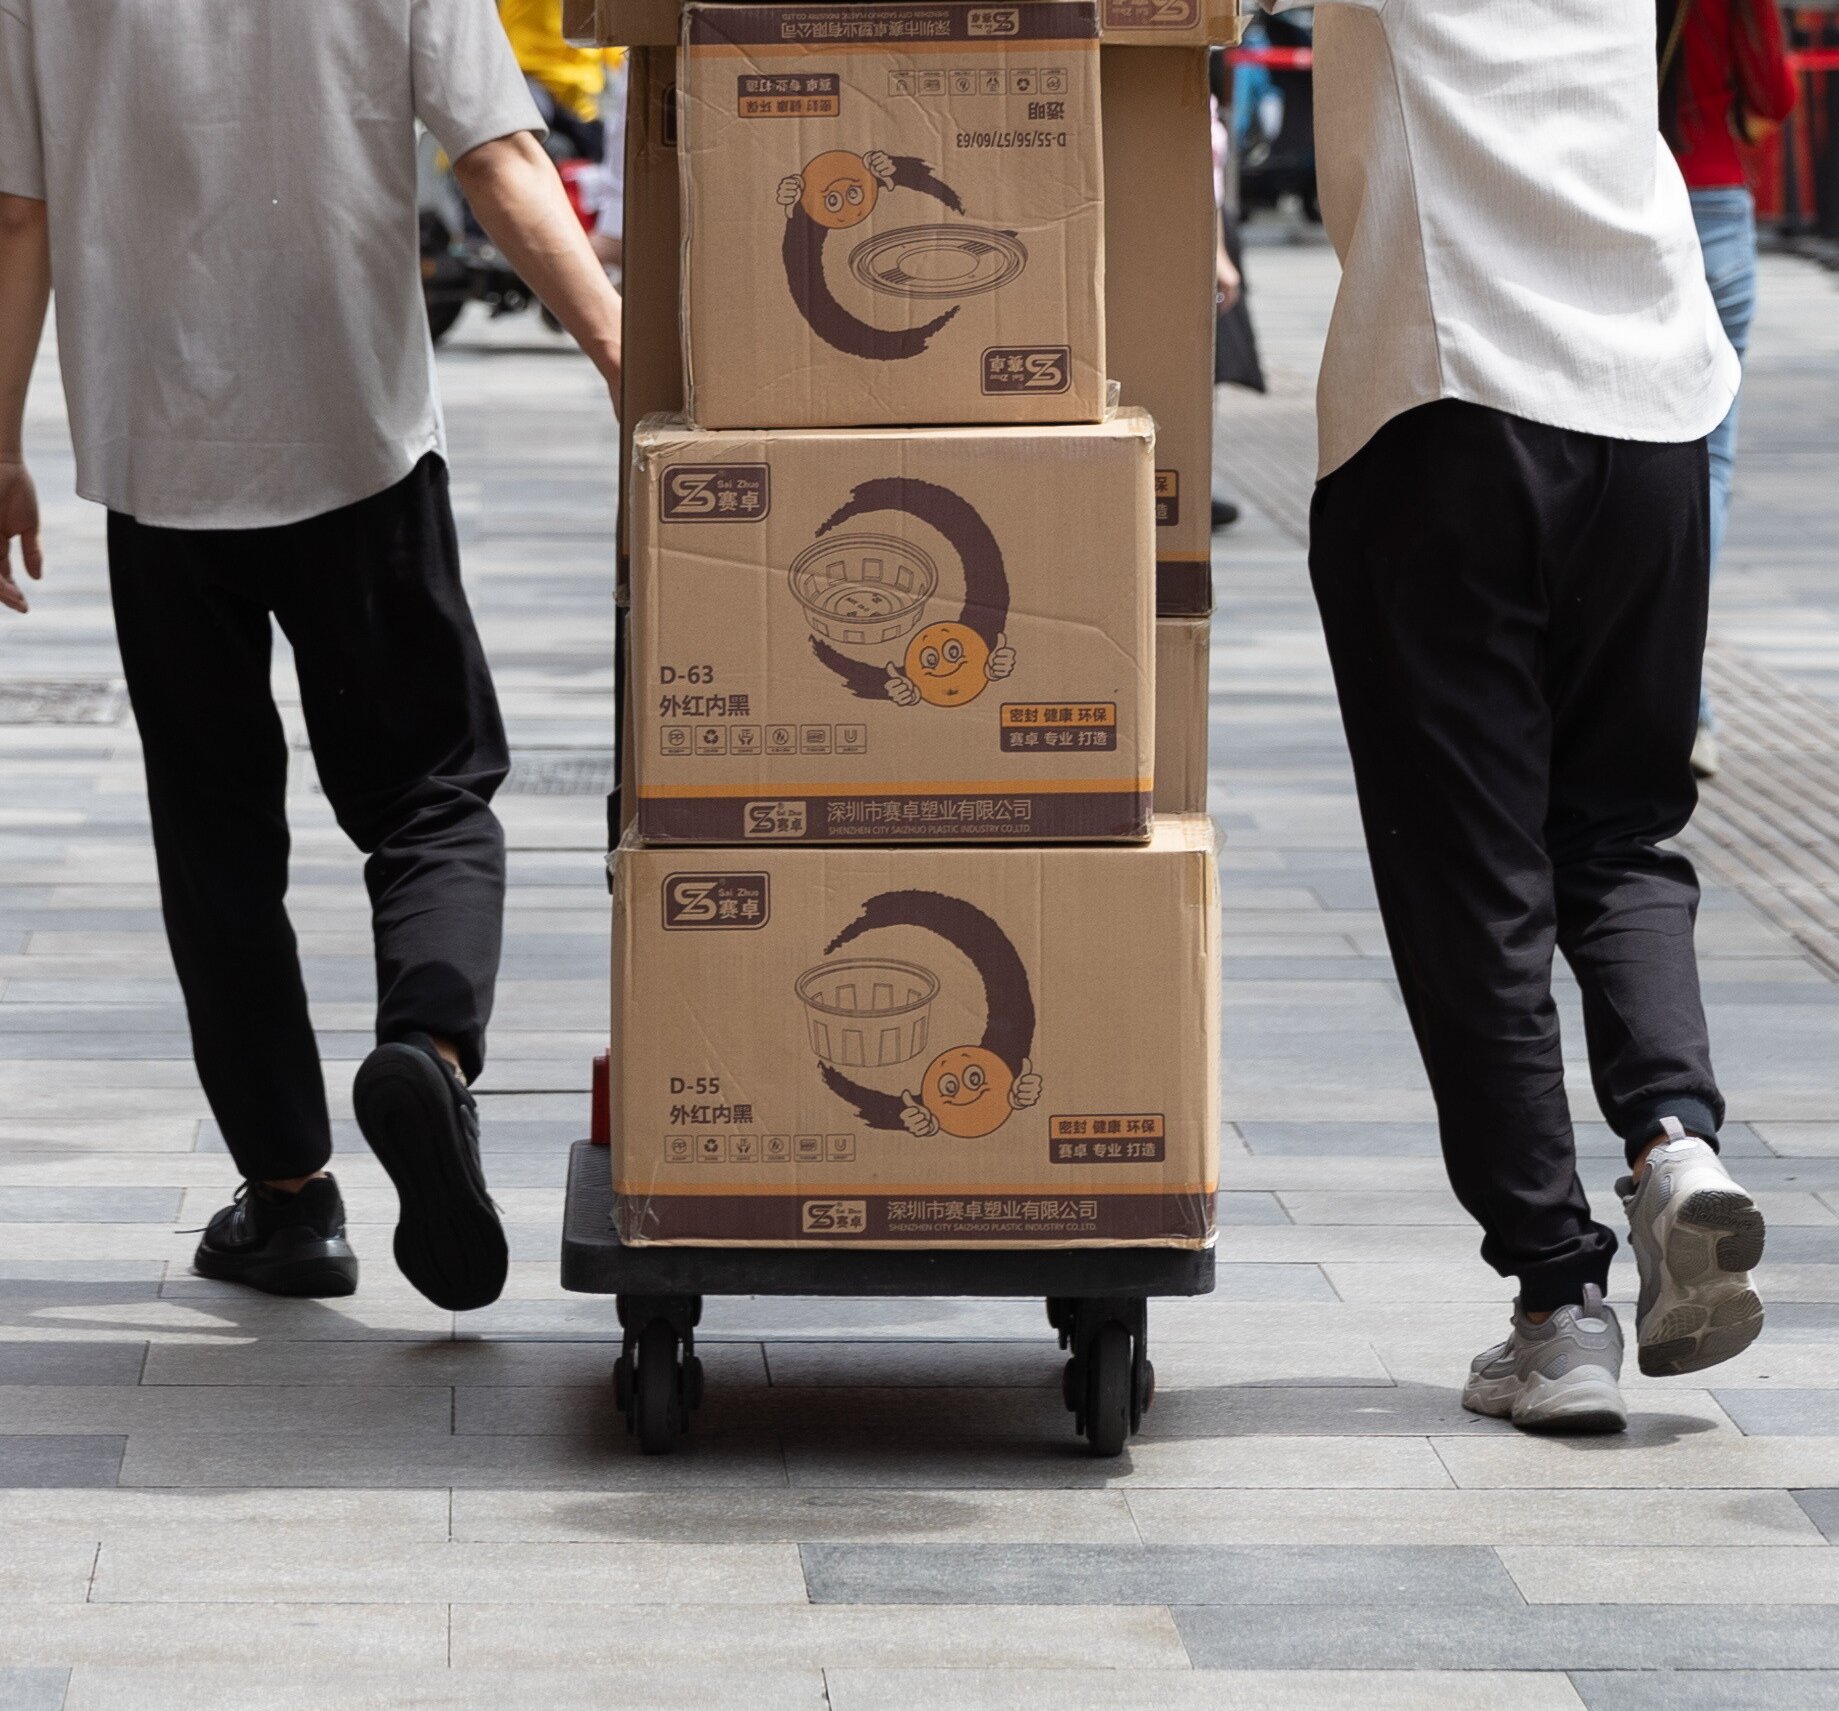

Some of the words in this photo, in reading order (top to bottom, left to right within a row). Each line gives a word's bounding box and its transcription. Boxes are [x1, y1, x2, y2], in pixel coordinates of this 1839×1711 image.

[781, 19, 951, 38] 深圳市赛卓塑业有限公司
[745, 80, 772, 92] 打造
[776, 79, 801, 92] 专业
[1028, 101, 1065, 120] 透明
[956, 131, 1067, 148] D-55/56/57/60/63
[988, 355, 1024, 373] 赛卓
[718, 490, 760, 512] 赛卓
[660, 665, 714, 685] D-63
[660, 694, 751, 718] 外红内黑
[1010, 708, 1038, 723] 密封
[1044, 708, 1072, 723] 健康
[1078, 708, 1106, 723] 环保
[1010, 732, 1039, 747] 赛卓
[1044, 731, 1073, 745] 专业
[1078, 731, 1107, 745] 打造
[827, 799, 1032, 823] 深圳市赛卓塑业有限公司
[777, 817, 803, 833] 赛卓
[829, 826, 871, 836] SHENZHEN
[872, 826, 889, 835] CITY
[891, 825, 927, 835] SAIZHUO
[928, 825, 959, 834] PLASTIC
[961, 825, 1000, 834] INDUSTRY
[719, 899, 761, 919] 赛卓
[670, 1077, 720, 1094] D-55
[670, 1104, 753, 1125] 外红内黑
[1058, 1120, 1087, 1134] 密封
[1093, 1120, 1121, 1134] 健康
[1127, 1119, 1155, 1133] 环保
[1058, 1143, 1088, 1158] 赛卓
[1093, 1143, 1122, 1158] 专业
[1127, 1143, 1156, 1157] 打造
[887, 1200, 1098, 1221] 深圳市赛卓塑业有限公司
[889, 1222, 933, 1232] SHENZHEN
[934, 1222, 951, 1231] CITY
[953, 1222, 990, 1231] SAIZHUO
[991, 1222, 1023, 1231] PLASTIC
[1025, 1221, 1065, 1231] INDUSTRY
